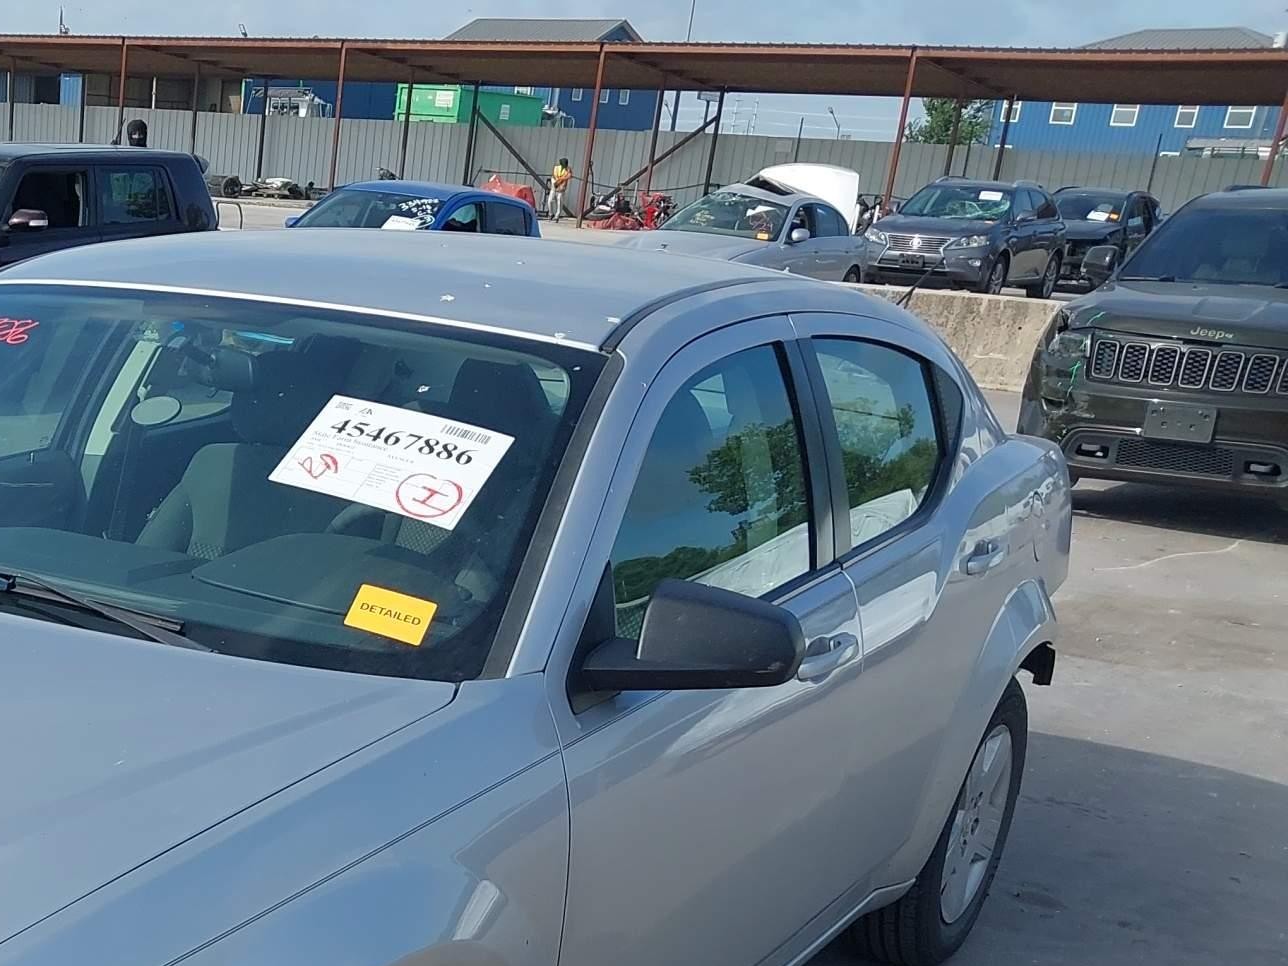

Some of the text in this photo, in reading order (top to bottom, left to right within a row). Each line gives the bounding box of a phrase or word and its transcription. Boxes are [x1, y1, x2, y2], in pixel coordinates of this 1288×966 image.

[1190, 326, 1225, 340] Jeep
[330, 419, 479, 465] 45467886
[359, 602, 422, 626] DETAILED
